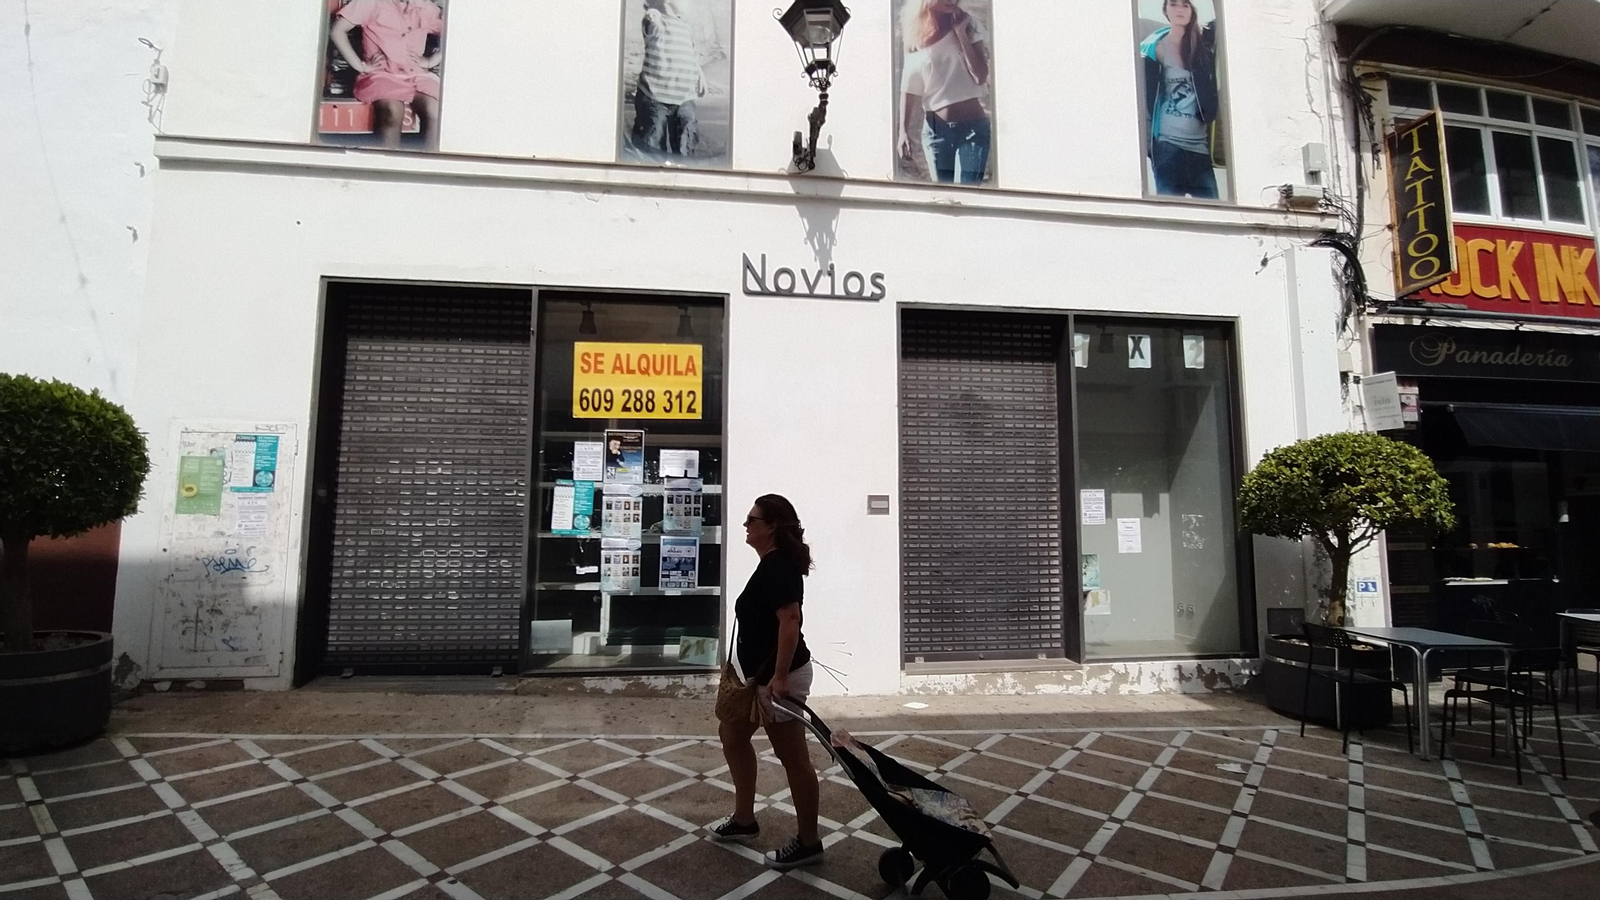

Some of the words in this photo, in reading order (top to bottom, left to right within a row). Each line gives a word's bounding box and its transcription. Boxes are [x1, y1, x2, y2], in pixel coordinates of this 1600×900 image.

[1400, 121, 1441, 280] TATTOO
[742, 251, 886, 302] Novios
[1424, 235, 1530, 301] OCK
[1532, 242, 1600, 306] INK
[580, 351, 605, 375] SE
[611, 353, 697, 378] ALQUILA
[1129, 335, 1145, 360] X
[1409, 332, 1573, 368] Panadería
[579, 387, 614, 412] 609
[621, 388, 656, 413] 288
[662, 389, 697, 414] 312
